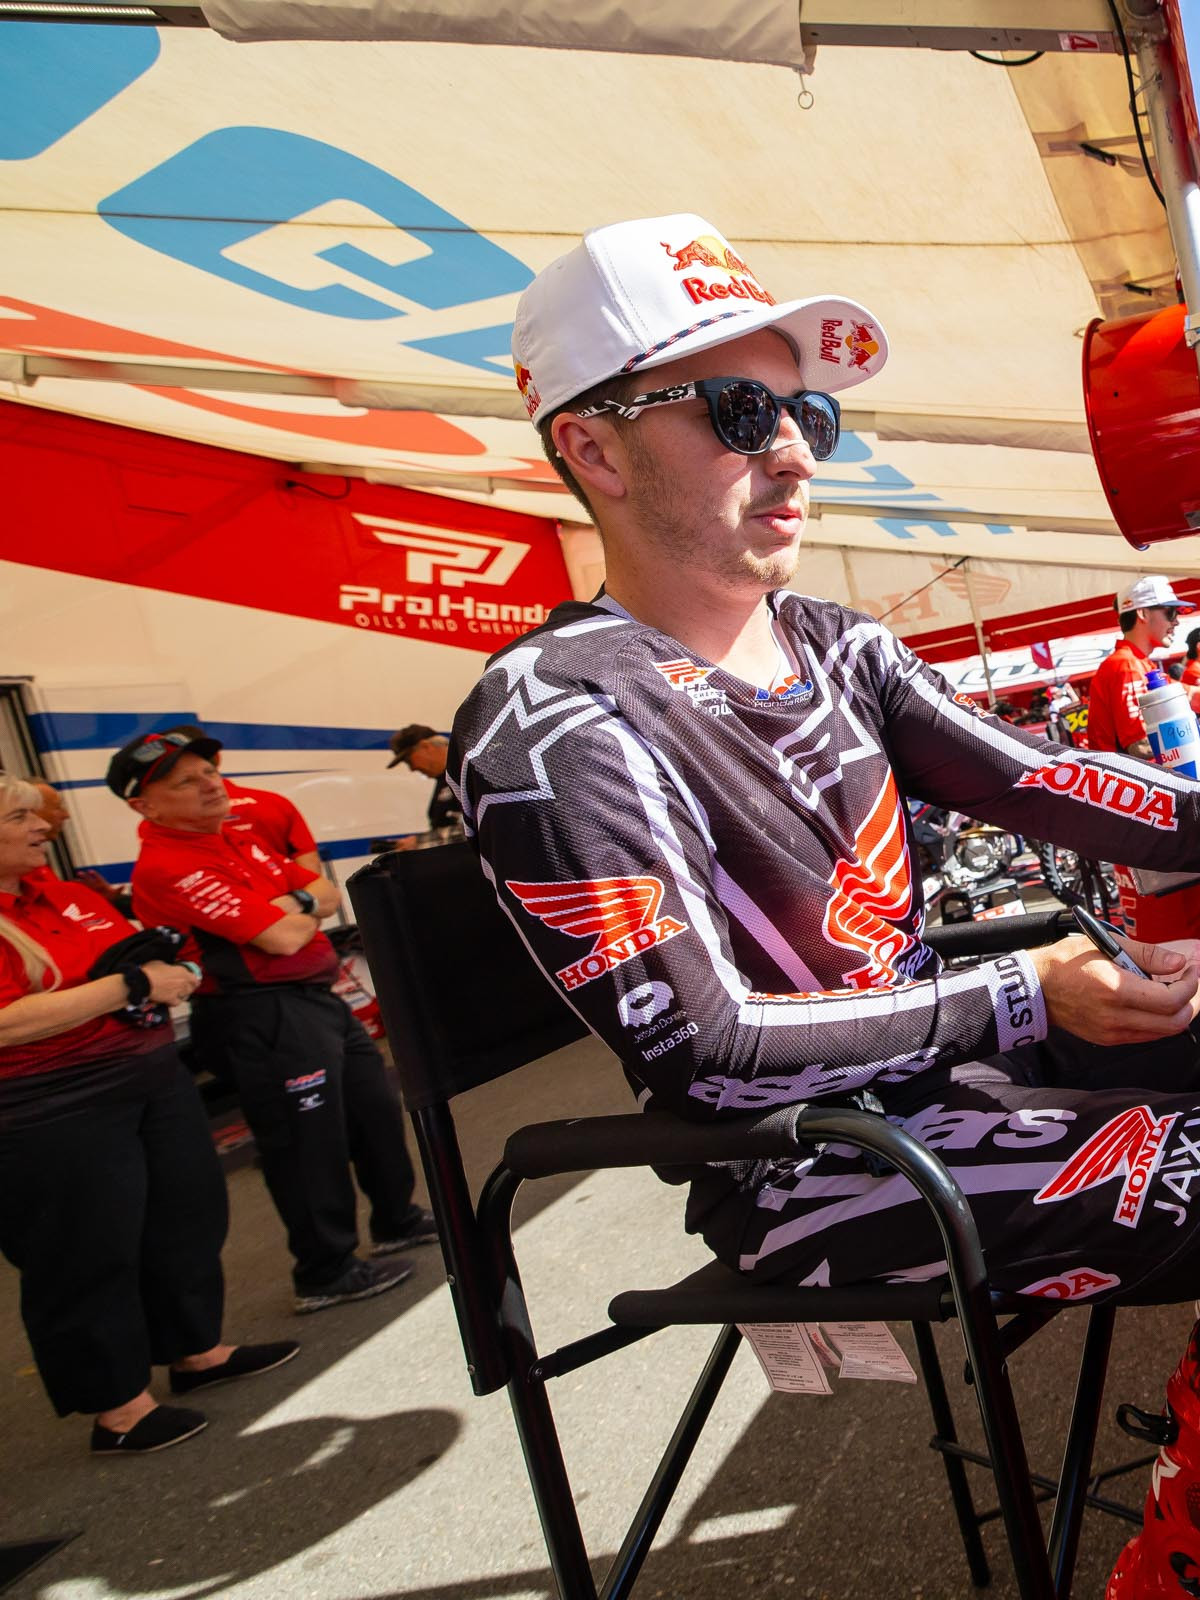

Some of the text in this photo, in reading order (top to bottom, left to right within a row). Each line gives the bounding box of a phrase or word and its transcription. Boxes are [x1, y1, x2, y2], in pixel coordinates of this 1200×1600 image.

[355, 612, 538, 636] OILS AND CHEMIC
[555, 915, 690, 991] HONDA
[641, 1021, 699, 1062] Insta360
[1114, 1111, 1182, 1228] HONDA
